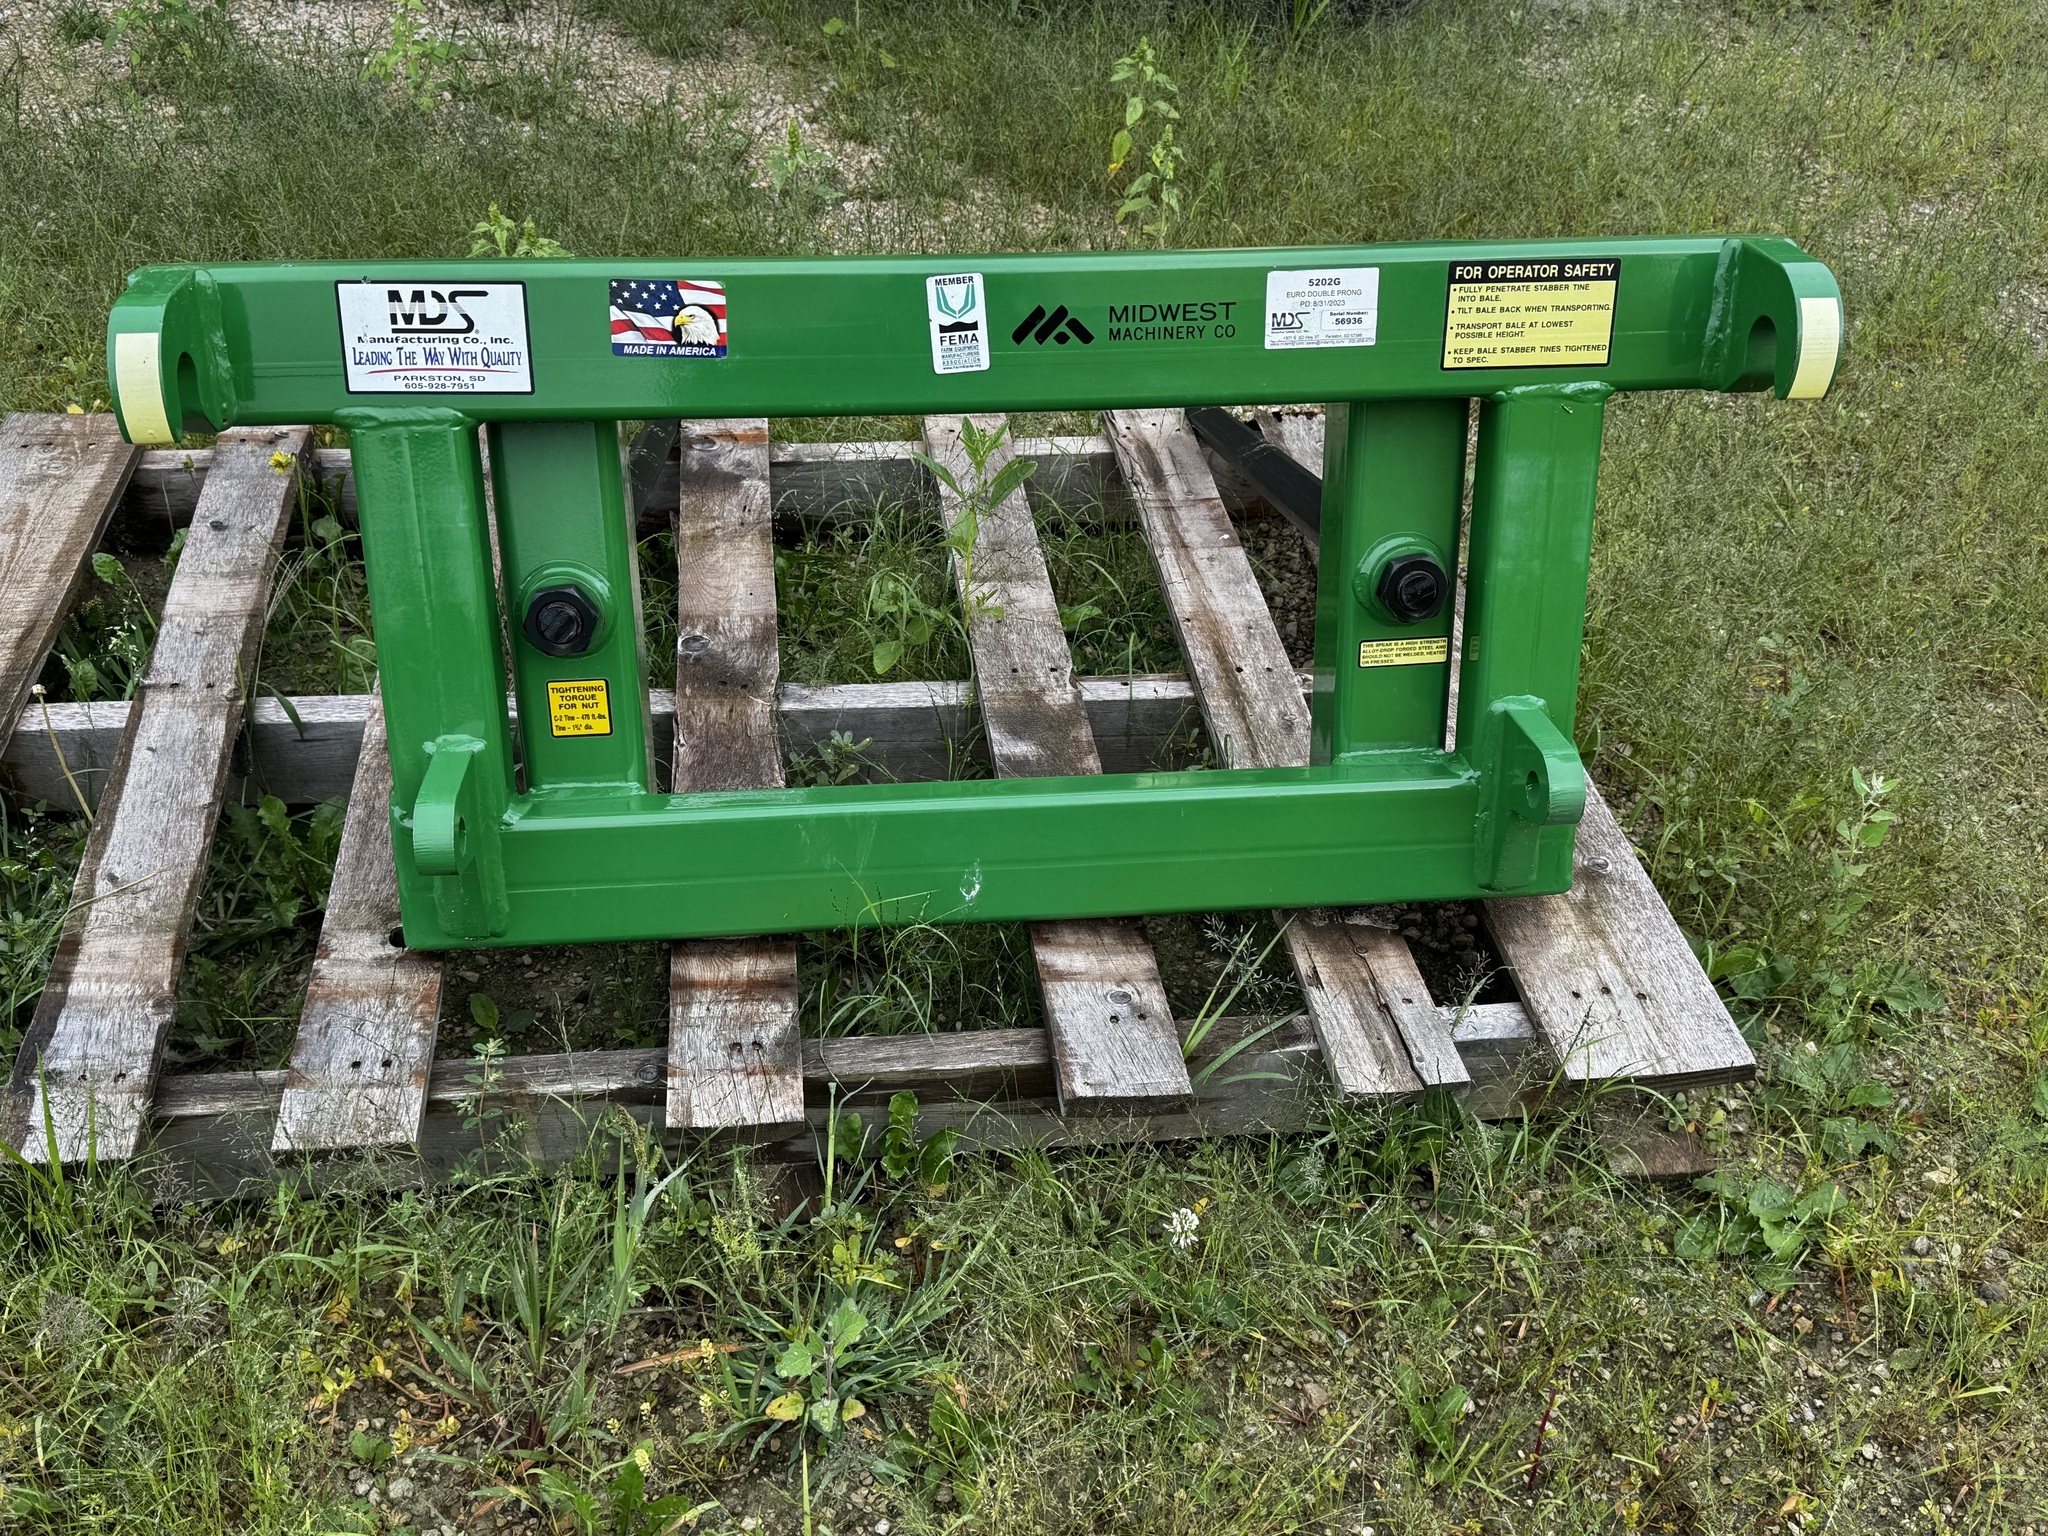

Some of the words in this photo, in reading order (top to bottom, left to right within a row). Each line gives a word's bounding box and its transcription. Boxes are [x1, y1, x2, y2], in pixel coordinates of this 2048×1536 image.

[1455, 266, 1482, 279] FOR
[1488, 265, 1558, 279] OPERATOR
[1564, 263, 1615, 277] SAFETY
[935, 276, 974, 287] MEMBER
[1308, 278, 1341, 286] 5202G
[1534, 284, 1570, 292] STABBER
[1337, 289, 1362, 297] PRONG
[387, 290, 489, 334] MDS
[1109, 302, 1237, 323] MIDWEST
[1551, 304, 1612, 312] TRANSPORTING.
[1271, 312, 1310, 330] MDS
[1335, 317, 1362, 325] 56936
[1456, 322, 1502, 330] TRANSPORT
[1541, 320, 1573, 328] LOWEST
[1109, 325, 1206, 341] MACHINERY
[1214, 324, 1236, 339] CO
[1496, 330, 1525, 338] HEIGHT.
[357, 336, 460, 345] Manufacturing
[463, 336, 487, 345] Co.,
[490, 336, 514, 345] Inc.
[940, 333, 979, 346] FEMA
[623, 345, 654, 355] MADE
[656, 346, 667, 355] IN
[669, 346, 717, 356] AMERICA
[1564, 344, 1607, 352] TIGHTENED
[550, 686, 604, 694] TIGHTENING
[560, 694, 597, 702] TORQUE
